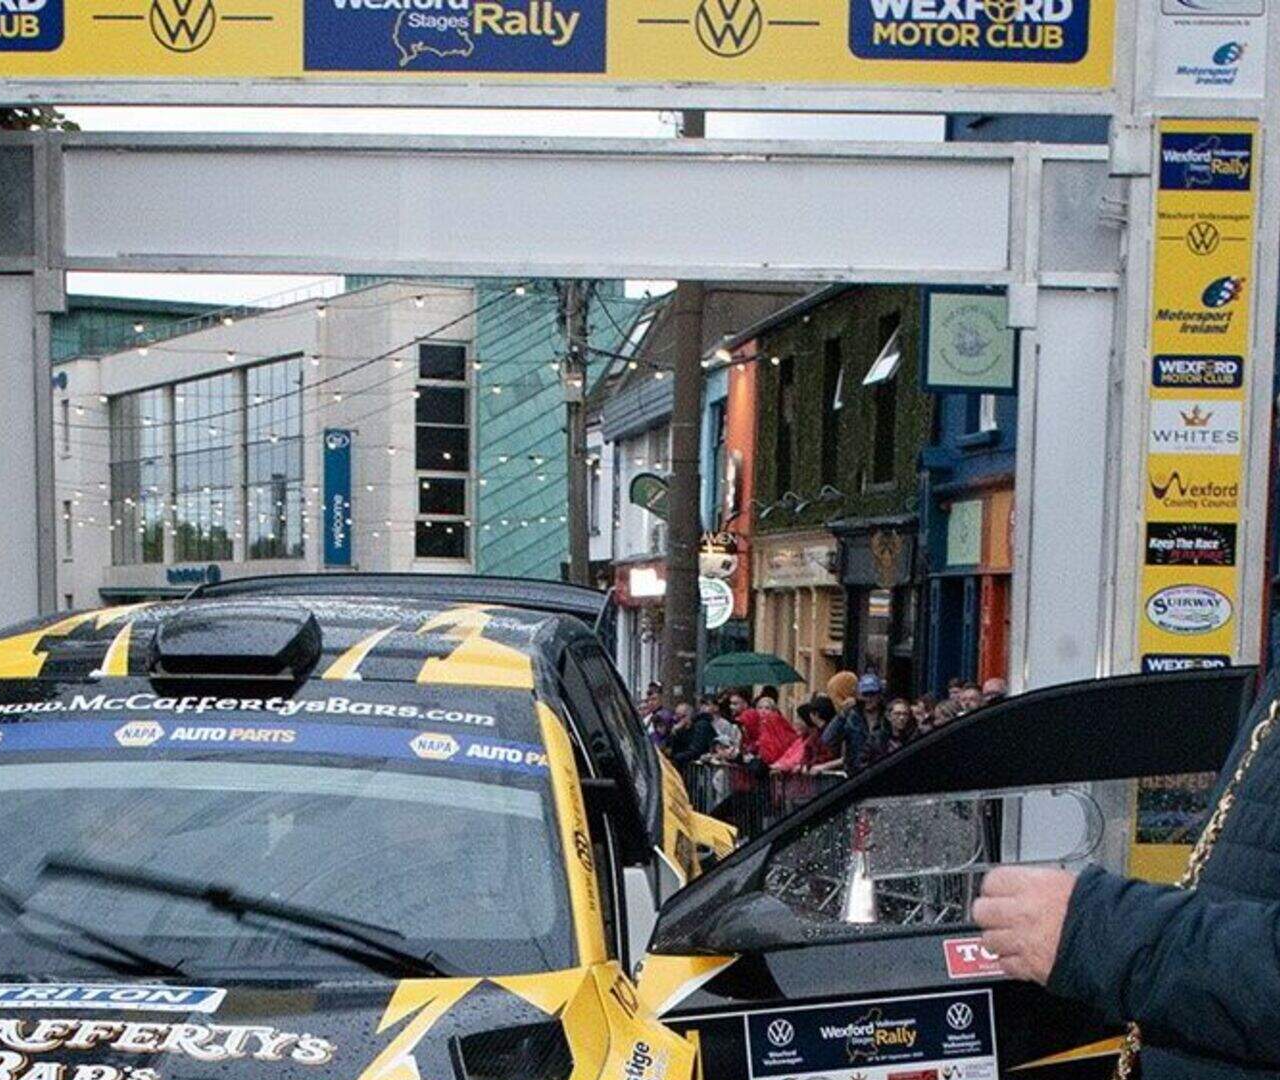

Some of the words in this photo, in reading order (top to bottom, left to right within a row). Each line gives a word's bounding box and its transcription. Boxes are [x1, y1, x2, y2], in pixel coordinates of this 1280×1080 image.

[408, 13, 469, 30] Stages
[474, 2, 580, 46] Rally
[873, 22, 980, 48] MOTOR
[986, 23, 1064, 49] CLUB
[1163, 150, 1212, 163] Wexford
[1211, 158, 1250, 179] Rally
[1156, 309, 1233, 322] Motorsport
[1179, 322, 1229, 333] Ireland
[1158, 360, 1238, 374] WEXFORD
[1161, 373, 1202, 384] MOTOR
[1204, 374, 1234, 384] CLUB
[1152, 430, 1240, 443] WHITES
[1150, 471, 1238, 499] Wexford
[1163, 499, 1198, 509] County
[1199, 499, 1237, 508] Council
[1148, 538, 1176, 549] Keep
[1176, 537, 1194, 549] The
[1194, 538, 1220, 549] Race
[122, 725, 158, 739] NAPA
[170, 727, 227, 741] AUTO
[227, 728, 296, 743] PARTS
[419, 735, 453, 752] NAPA
[466, 743, 522, 764] AUTO
[526, 752, 549, 767] PA
[820, 1022, 874, 1039] Wexford
[875, 1027, 917, 1047] Rally
